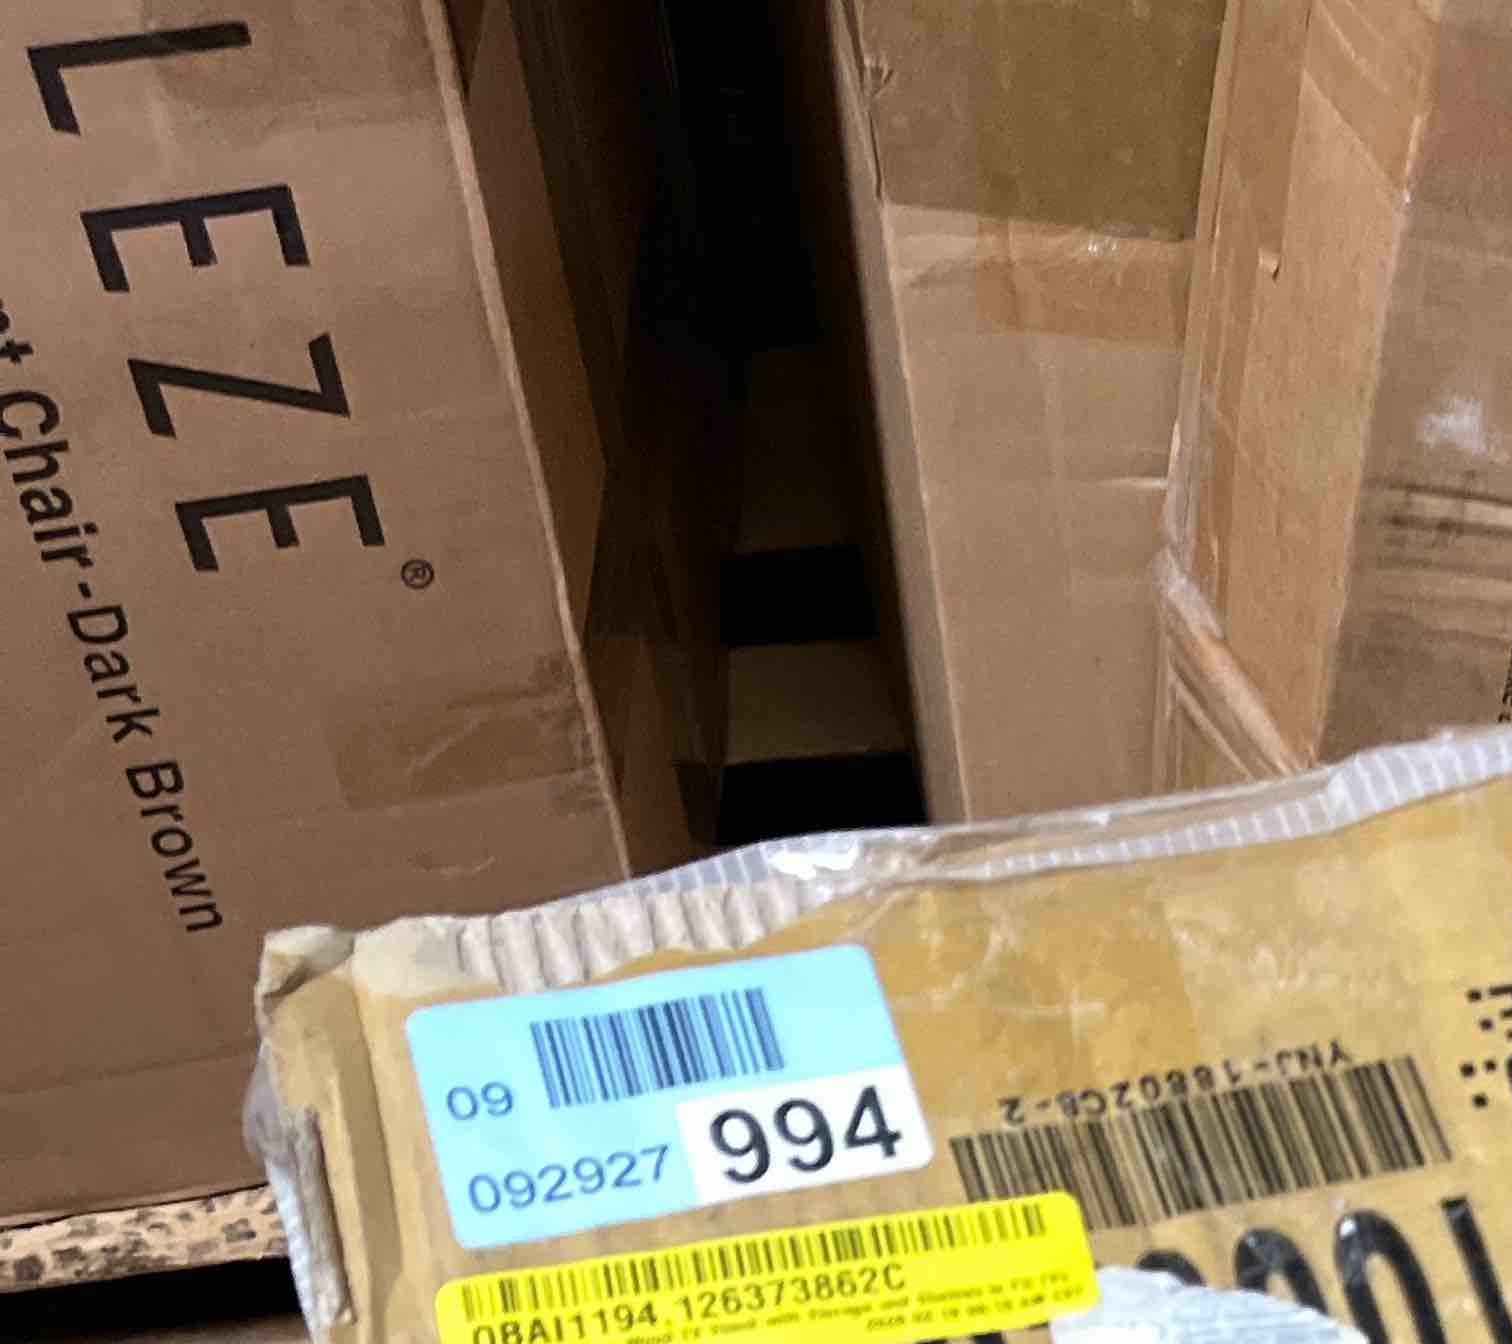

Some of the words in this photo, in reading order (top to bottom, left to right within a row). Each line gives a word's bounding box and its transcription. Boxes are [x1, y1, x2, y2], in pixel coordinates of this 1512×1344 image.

[126, 759, 224, 932] Brown
[445, 1080, 515, 1121] 09
[467, 1142, 671, 1214] 092927
[709, 1085, 903, 1186] 994
